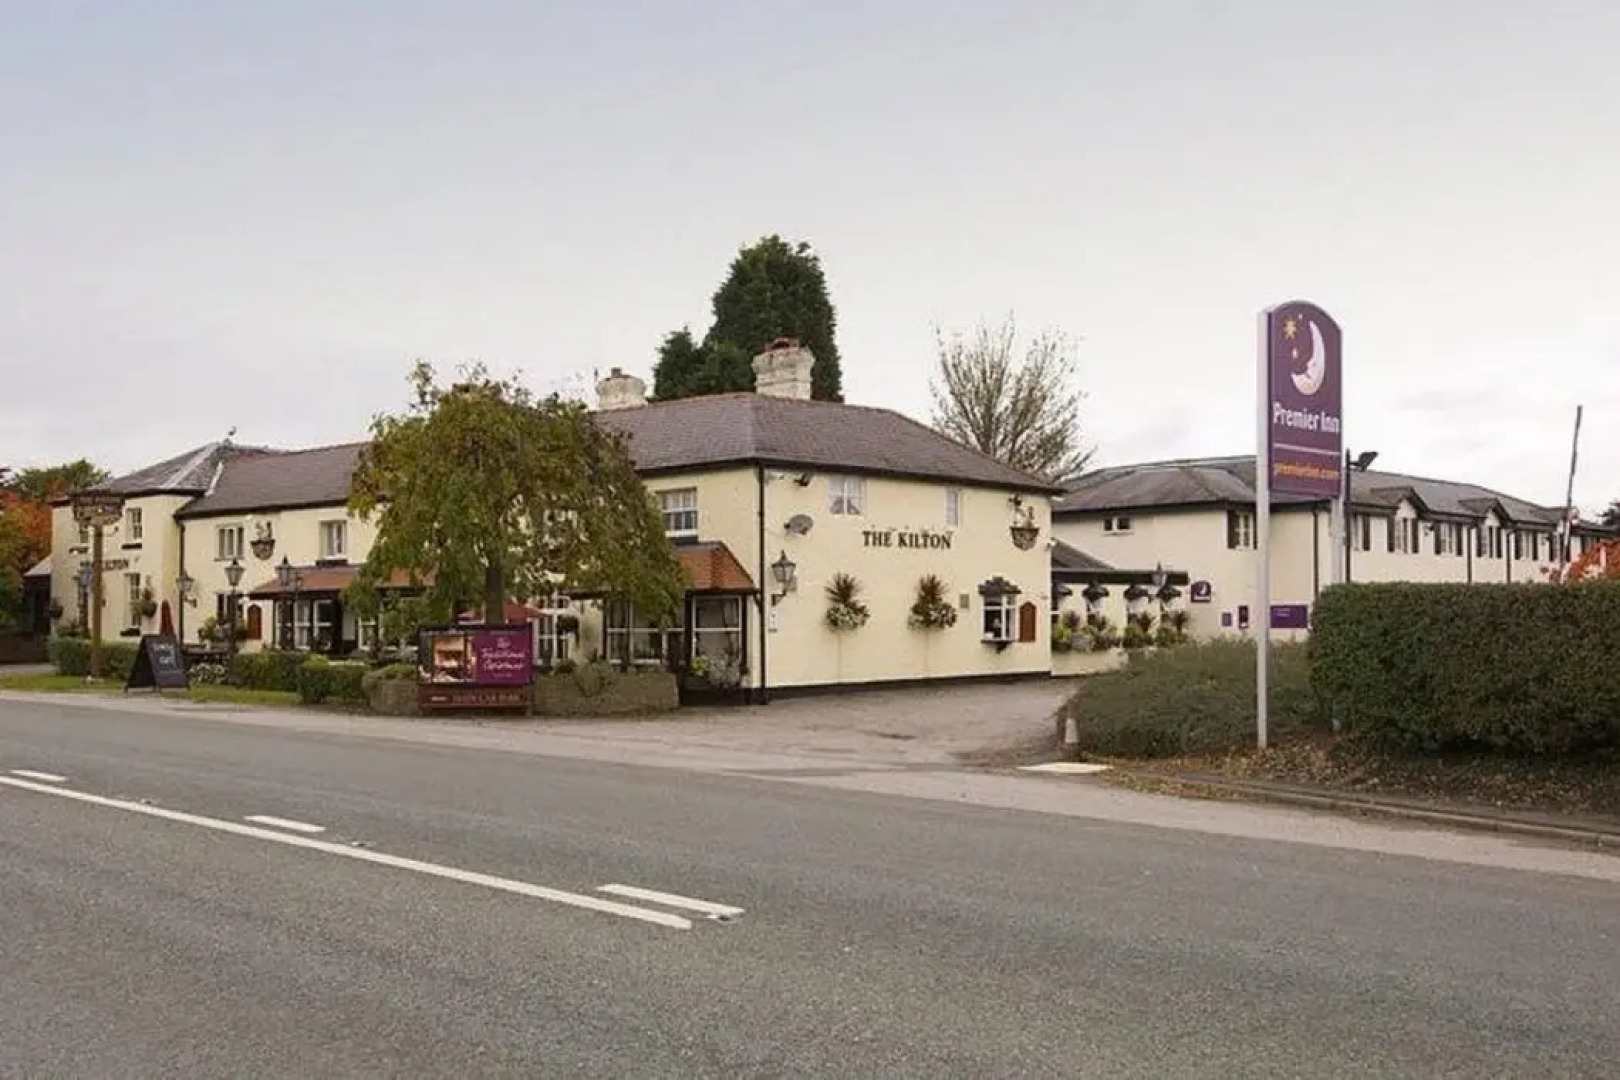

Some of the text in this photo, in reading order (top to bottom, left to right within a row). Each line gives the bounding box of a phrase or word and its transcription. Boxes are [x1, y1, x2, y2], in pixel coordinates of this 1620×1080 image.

[1273, 401, 1340, 433] Premier Inn
[862, 530, 954, 549] THE KILTON
